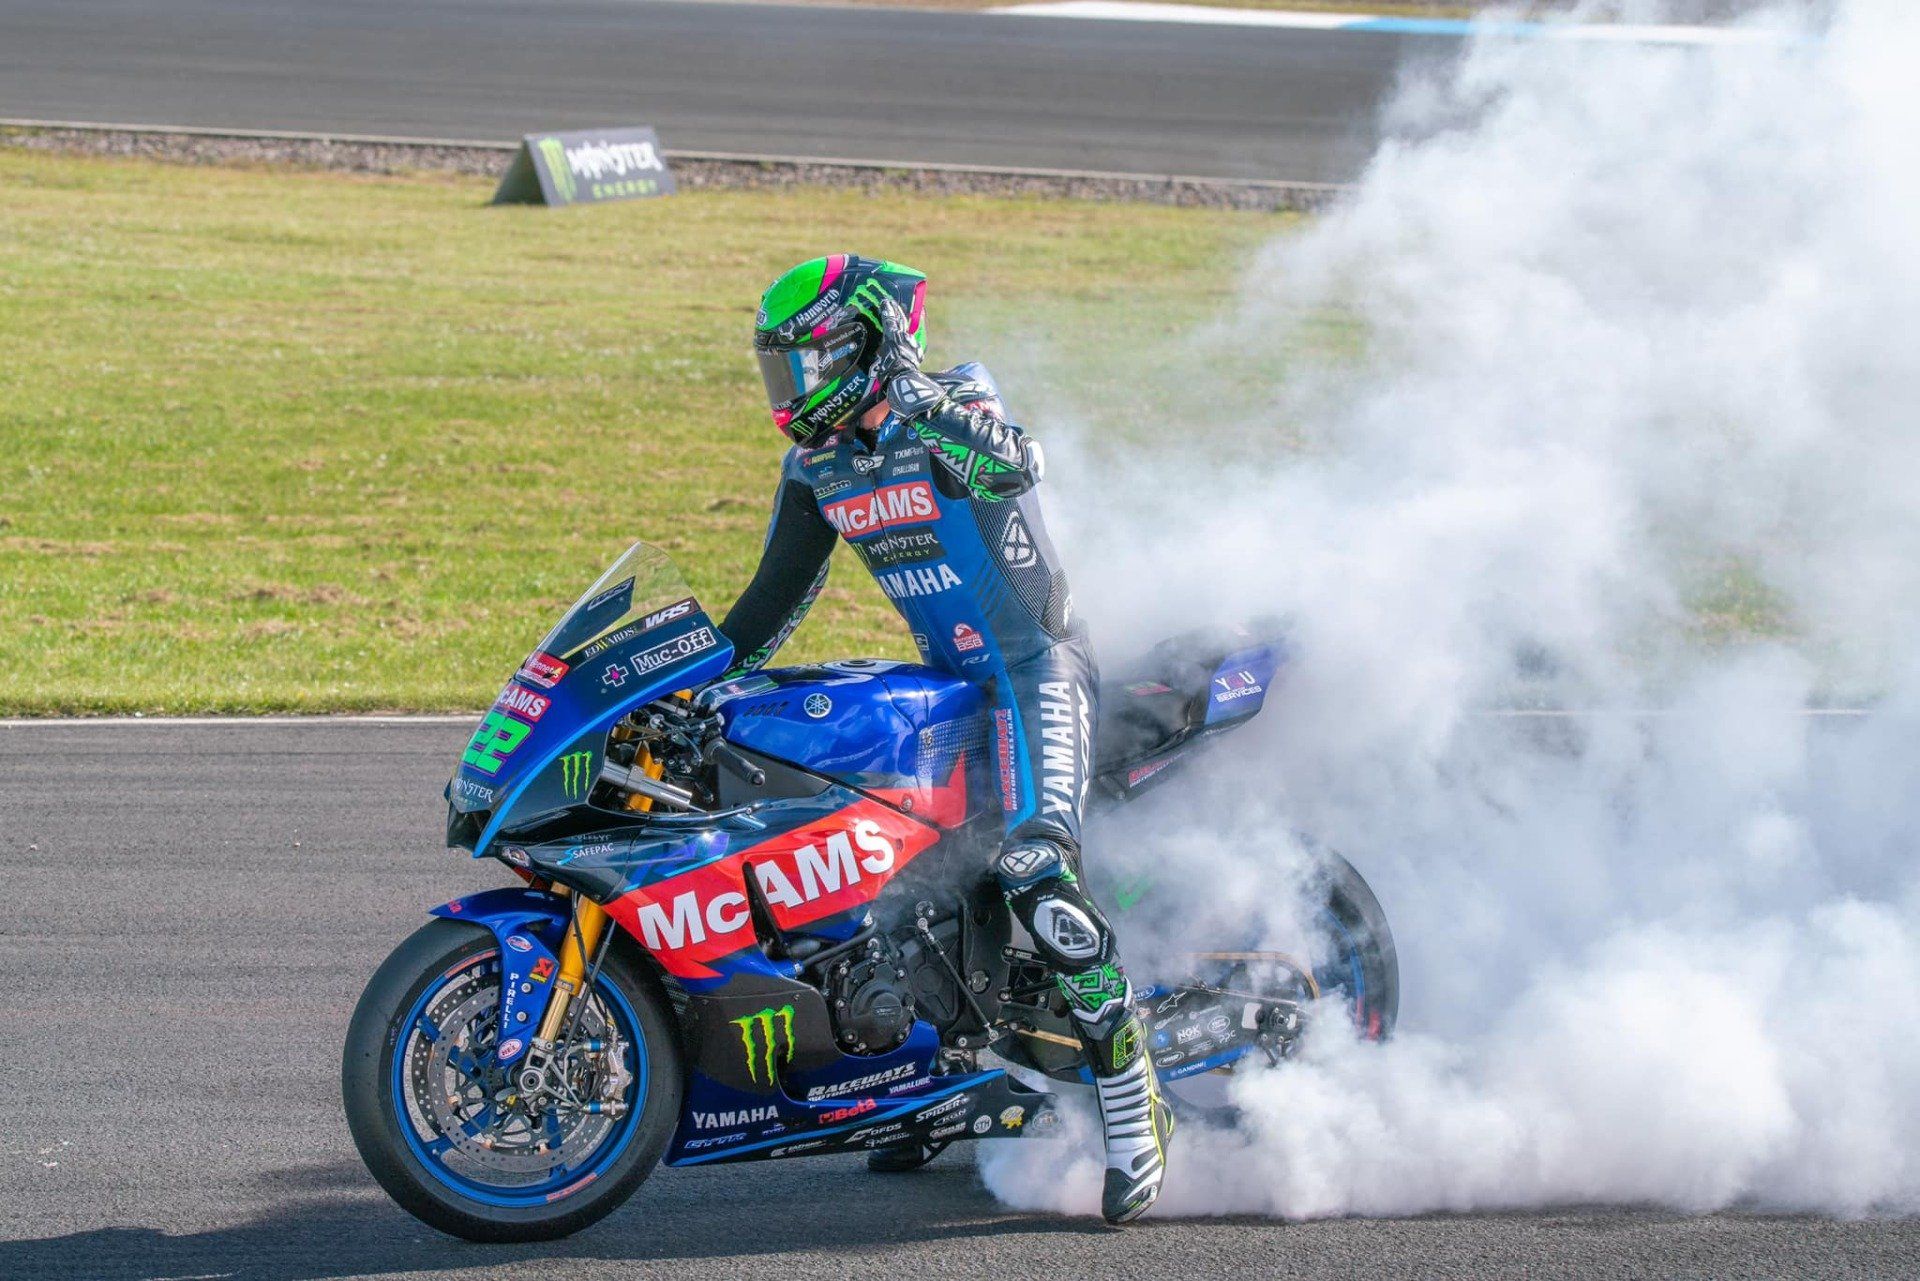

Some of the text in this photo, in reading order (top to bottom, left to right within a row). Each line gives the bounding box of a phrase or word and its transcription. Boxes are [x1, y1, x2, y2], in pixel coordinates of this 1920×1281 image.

[808, 375, 866, 424] MONSTER
[827, 486, 933, 534] McAMS
[868, 533, 939, 555] MONSTER
[879, 563, 962, 599] AMAHA
[644, 600, 691, 628] WRS
[634, 630, 709, 672] Muc-Off
[499, 687, 547, 717] cAMS
[1214, 685, 1262, 703] SERVICES
[463, 711, 532, 773] 22
[1038, 681, 1075, 815] YAMAHA
[455, 777, 494, 804] ONSTER
[572, 842, 615, 860] SAFEPAC
[637, 819, 895, 951] McAMS
[503, 972, 519, 1029] PIRELLI
[1176, 1024, 1202, 1040] NGK
[807, 1061, 916, 1098] RACEWAYS
[889, 1075, 932, 1094] YAMALUBE
[692, 1105, 779, 1129] YAMAHA
[835, 1098, 877, 1119] Beta
